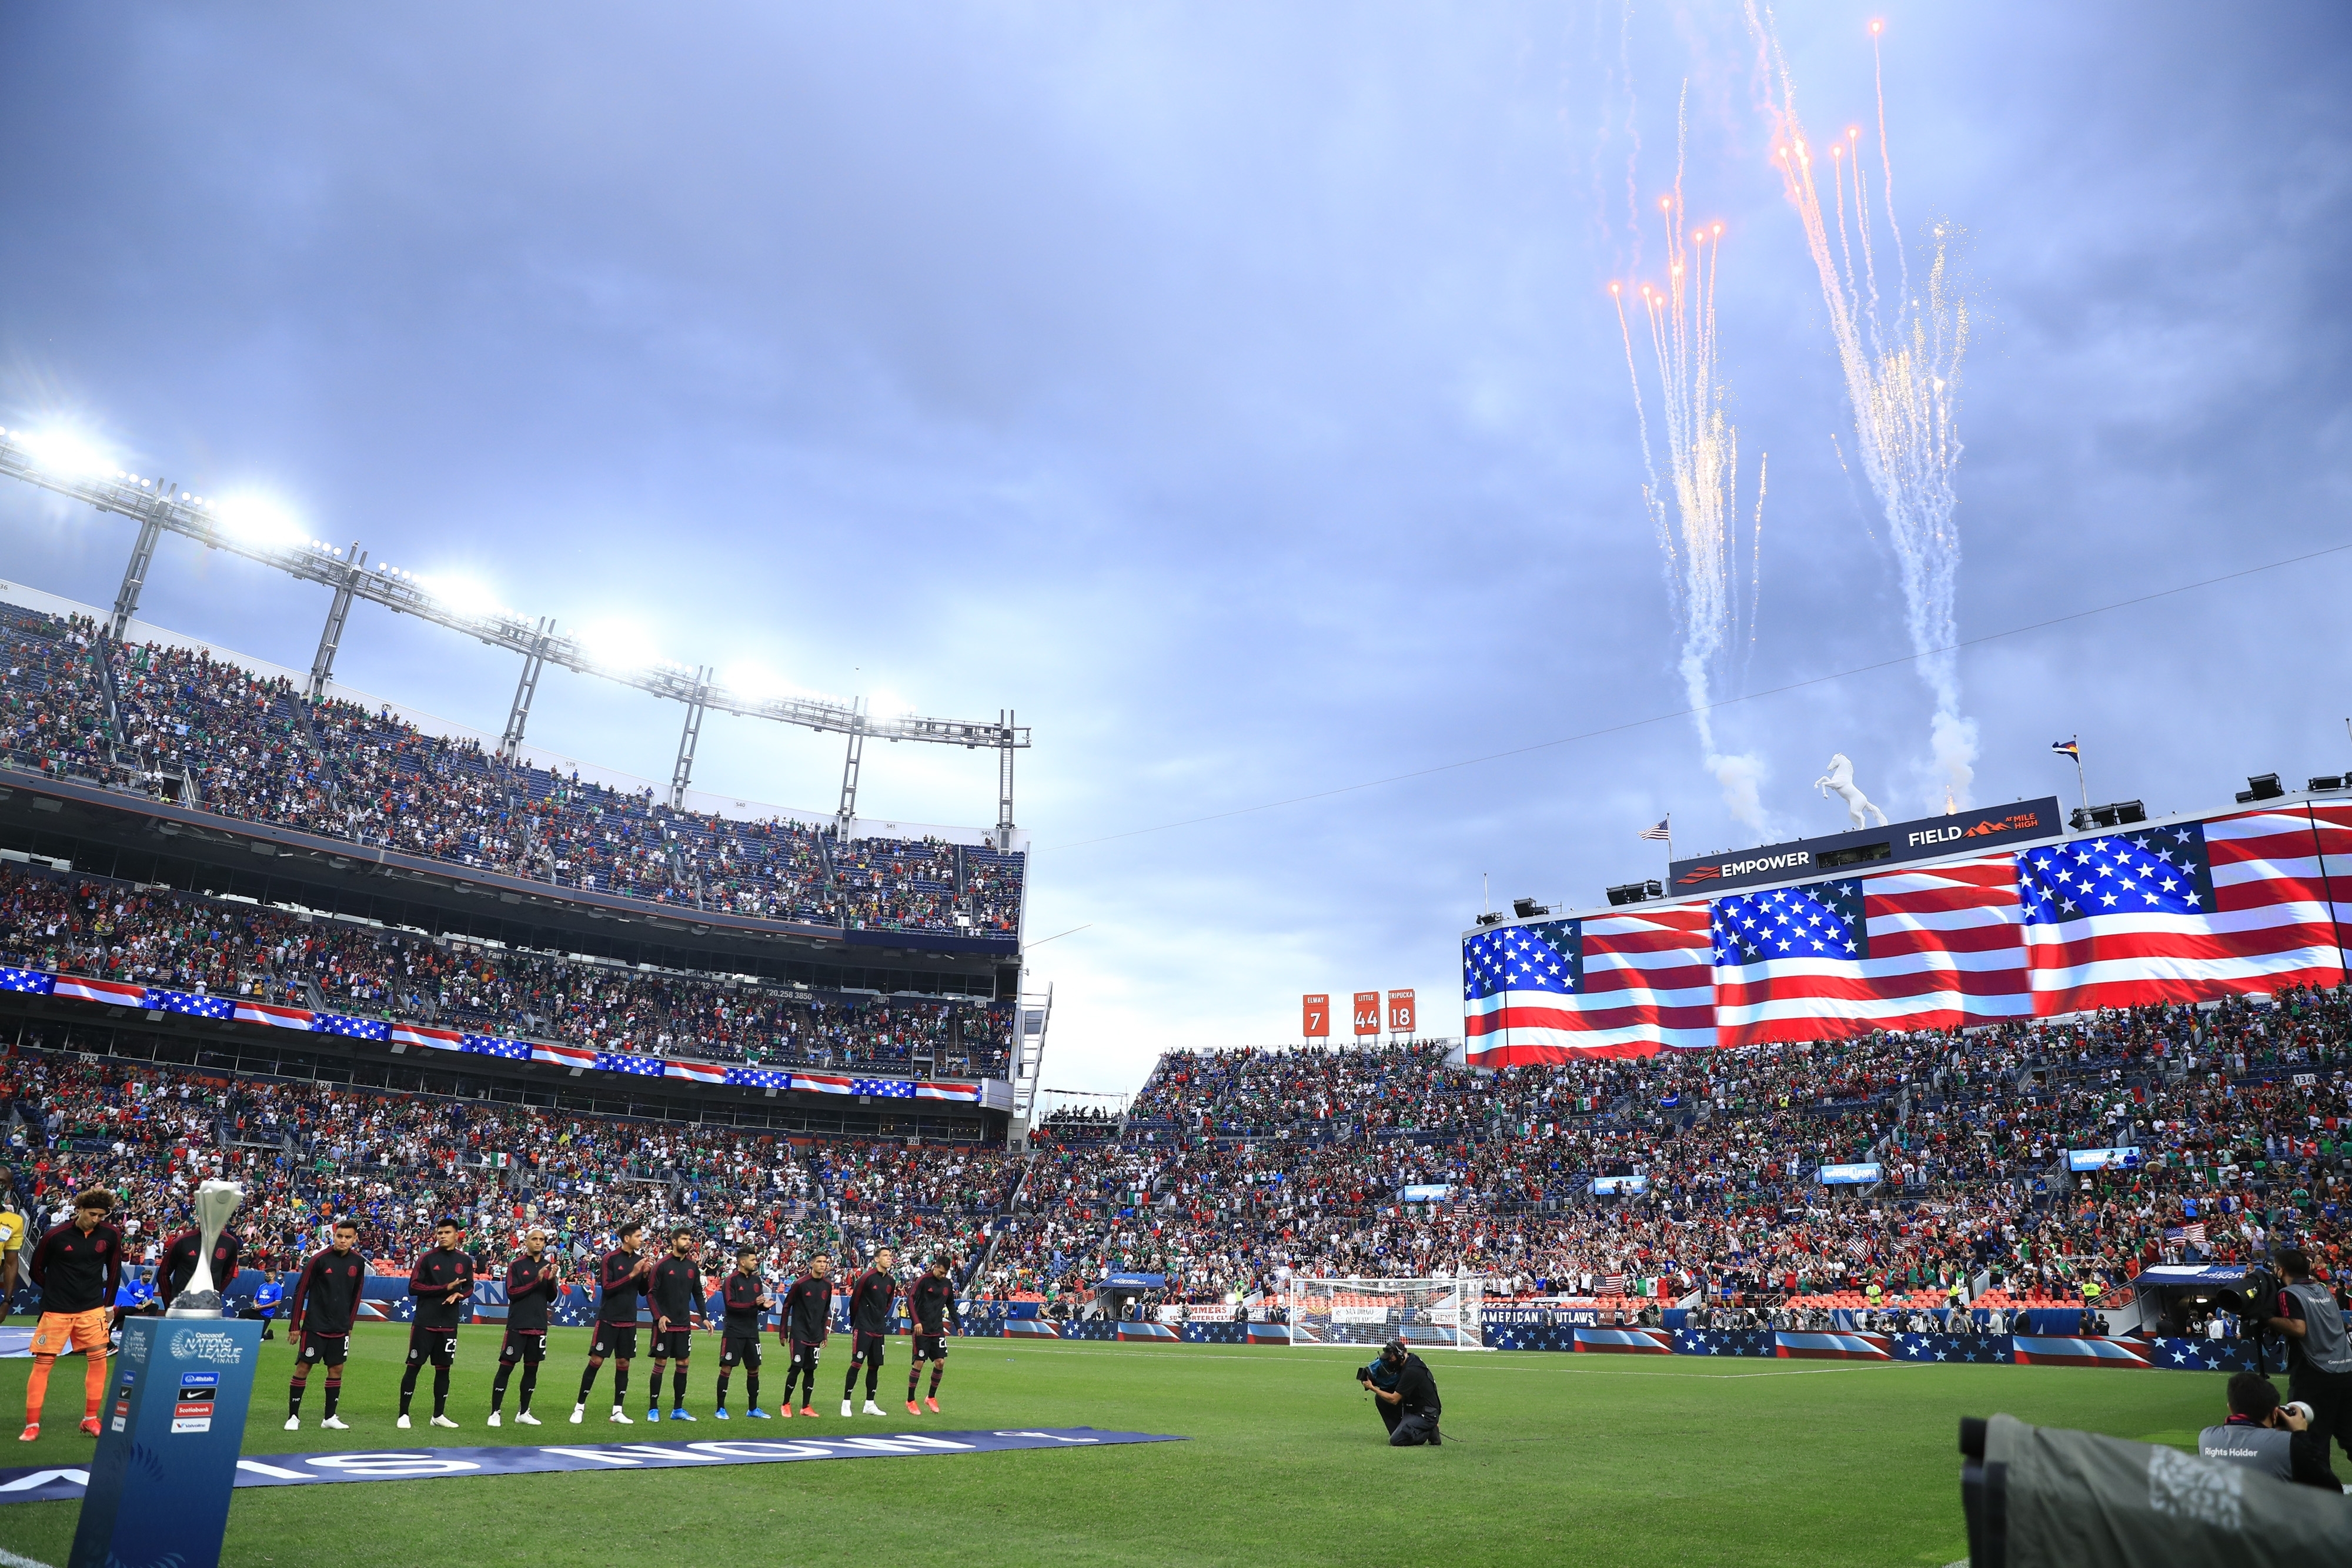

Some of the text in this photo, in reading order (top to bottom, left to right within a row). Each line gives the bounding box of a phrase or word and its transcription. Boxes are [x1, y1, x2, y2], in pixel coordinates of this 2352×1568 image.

[2013, 813, 2036, 823] MILE
[2014, 819, 2039, 830] HIGH
[1721, 826, 1963, 878] EMPOWER FIELD
[455, 944, 481, 952] RESECT
[487, 950, 502, 960] Fan
[794, 991, 812, 1000] 3850
[1310, 1012, 1321, 1030] 7
[1355, 1010, 1378, 1028] 44
[1392, 1008, 1410, 1026] 18
[81, 1055, 96, 1065] 125
[318, 1082, 330, 1090] 126
[1481, 1311, 1594, 1323] AMERICAN UTLAWS
[185, 1338, 233, 1349] NATIONS
[445, 1338, 457, 1352] 23
[539, 1335, 546, 1348] 2
[198, 1348, 243, 1359] LEAGUE
[540, 1435, 976, 1465] NOW
[2204, 1447, 2258, 1457] Rights Holder
